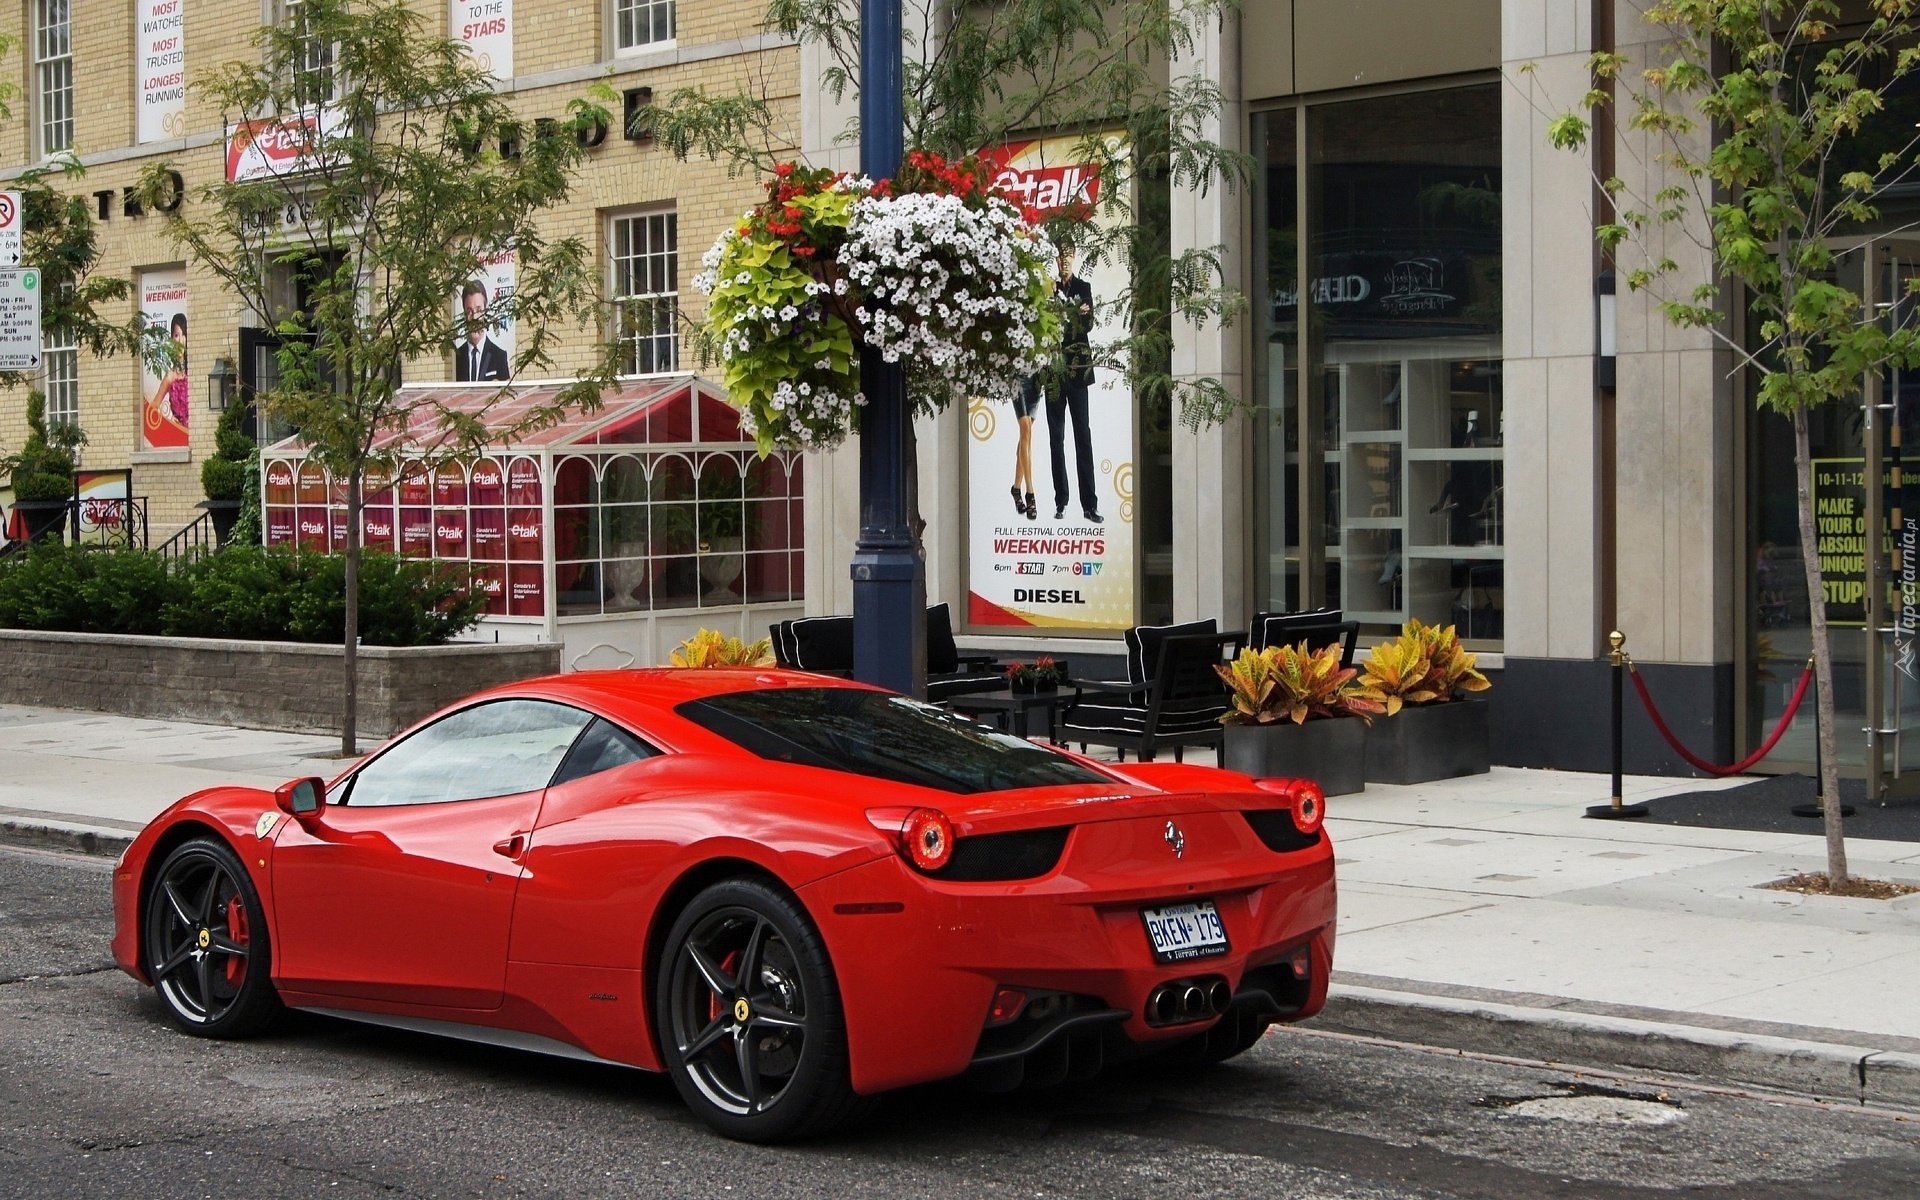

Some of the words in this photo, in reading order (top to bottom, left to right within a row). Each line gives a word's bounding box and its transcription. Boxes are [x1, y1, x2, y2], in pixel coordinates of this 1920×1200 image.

[152, 1, 178, 17] MOST
[469, 6, 482, 18] TO
[485, 2, 503, 15] THE
[463, 18, 506, 39] STARS
[152, 37, 178, 53] MOST
[146, 51, 183, 69] TRUSTED
[144, 72, 184, 90] LONGEST
[145, 87, 183, 105] RUNNING
[987, 167, 1093, 209] etalk
[286, 204, 297, 224] &
[6, 241, 18, 249] 6PM
[146, 290, 187, 302] WEEKNIGHT
[269, 473, 291, 485] etalk
[473, 472, 499, 485] etalk
[1818, 498, 1854, 515] MAKE
[301, 521, 324, 534] etalk
[366, 522, 391, 536] etalk
[437, 526, 463, 539] etalk
[512, 525, 538, 538] etalk
[994, 527, 1015, 536] FULL
[1016, 527, 1054, 536] FESTIVAL
[1057, 528, 1105, 536] COVERAGE
[1818, 517, 1852, 534] YOUR
[994, 539, 1105, 555] WEEKNIGHTS
[994, 564, 1012, 573] 6pm
[1052, 565, 1069, 573] 7pm
[1072, 561, 1103, 576] CTV
[1013, 588, 1086, 604] DIESEL
[1165, 905, 1195, 917] ONTARIO
[1149, 916, 1191, 948] BKEN
[1194, 912, 1223, 941] 179
[1175, 949, 1199, 959] Ferrari
